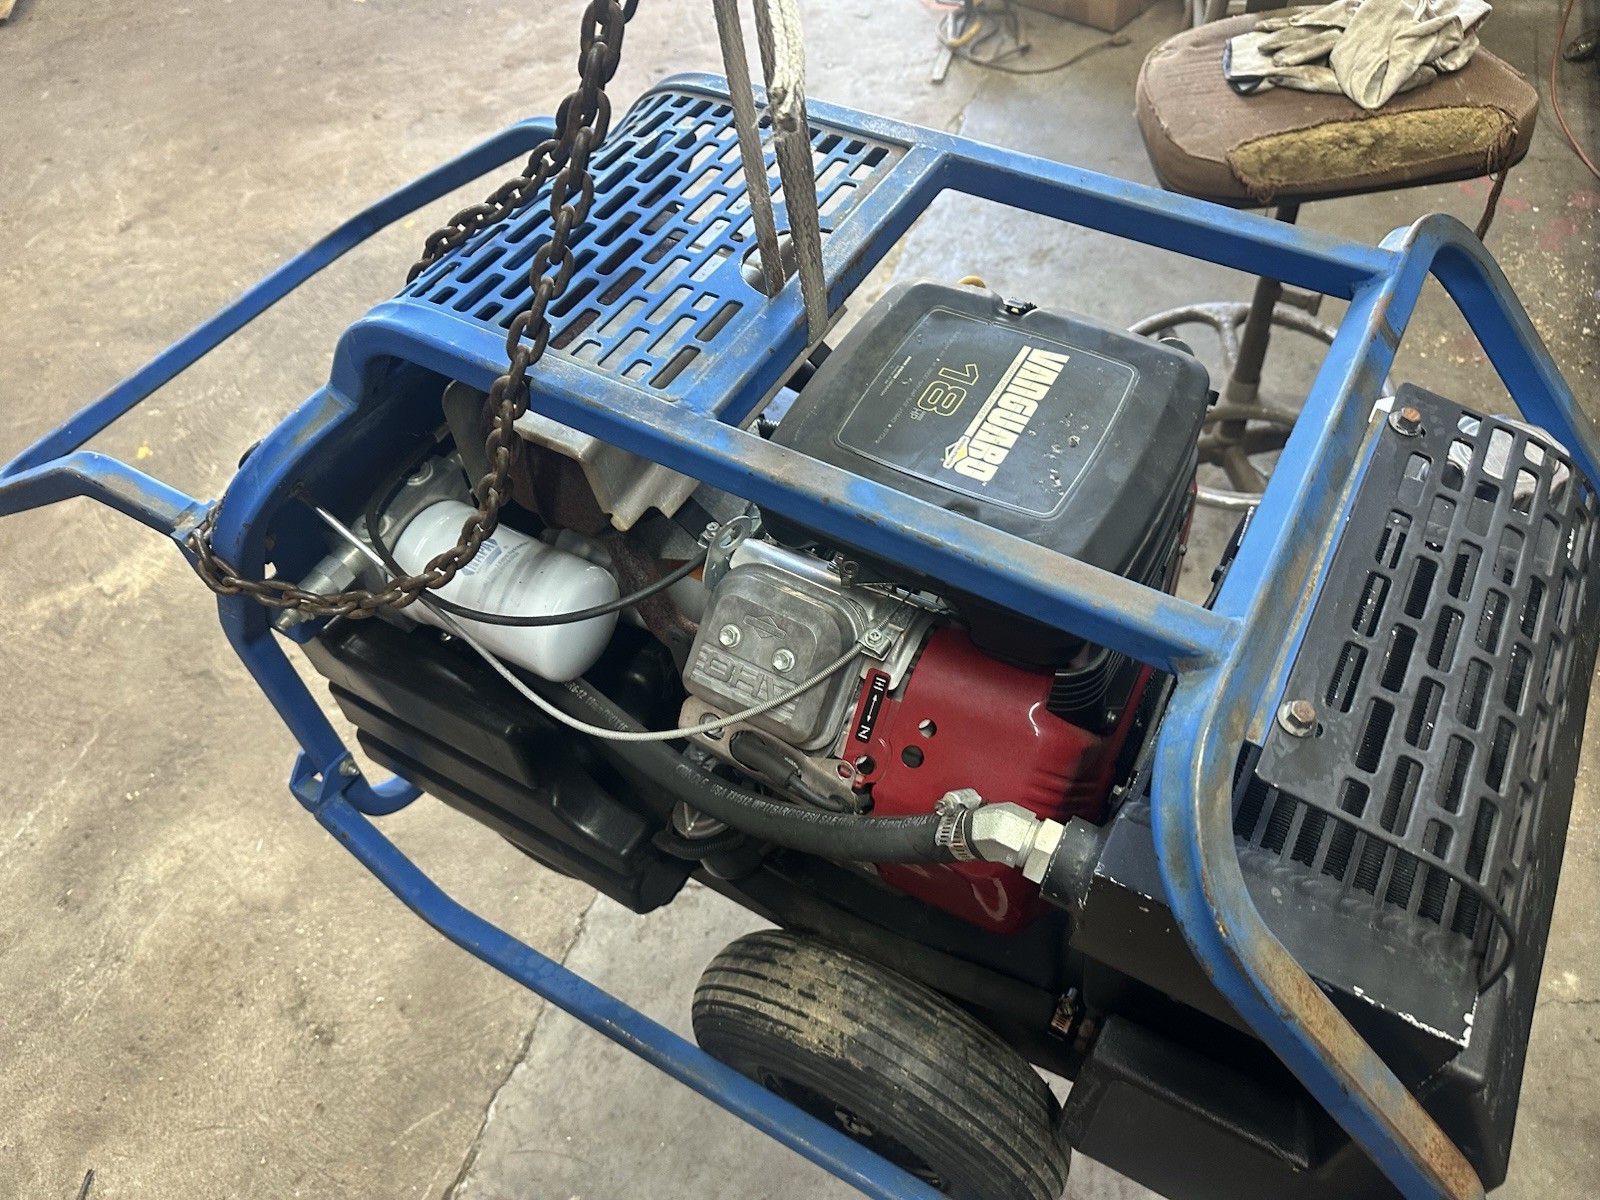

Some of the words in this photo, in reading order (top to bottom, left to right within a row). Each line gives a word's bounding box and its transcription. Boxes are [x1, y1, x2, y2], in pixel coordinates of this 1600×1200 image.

[917, 363, 979, 416] 18
[954, 348, 1071, 482] VANGUARD
[464, 540, 495, 573] NAPA
